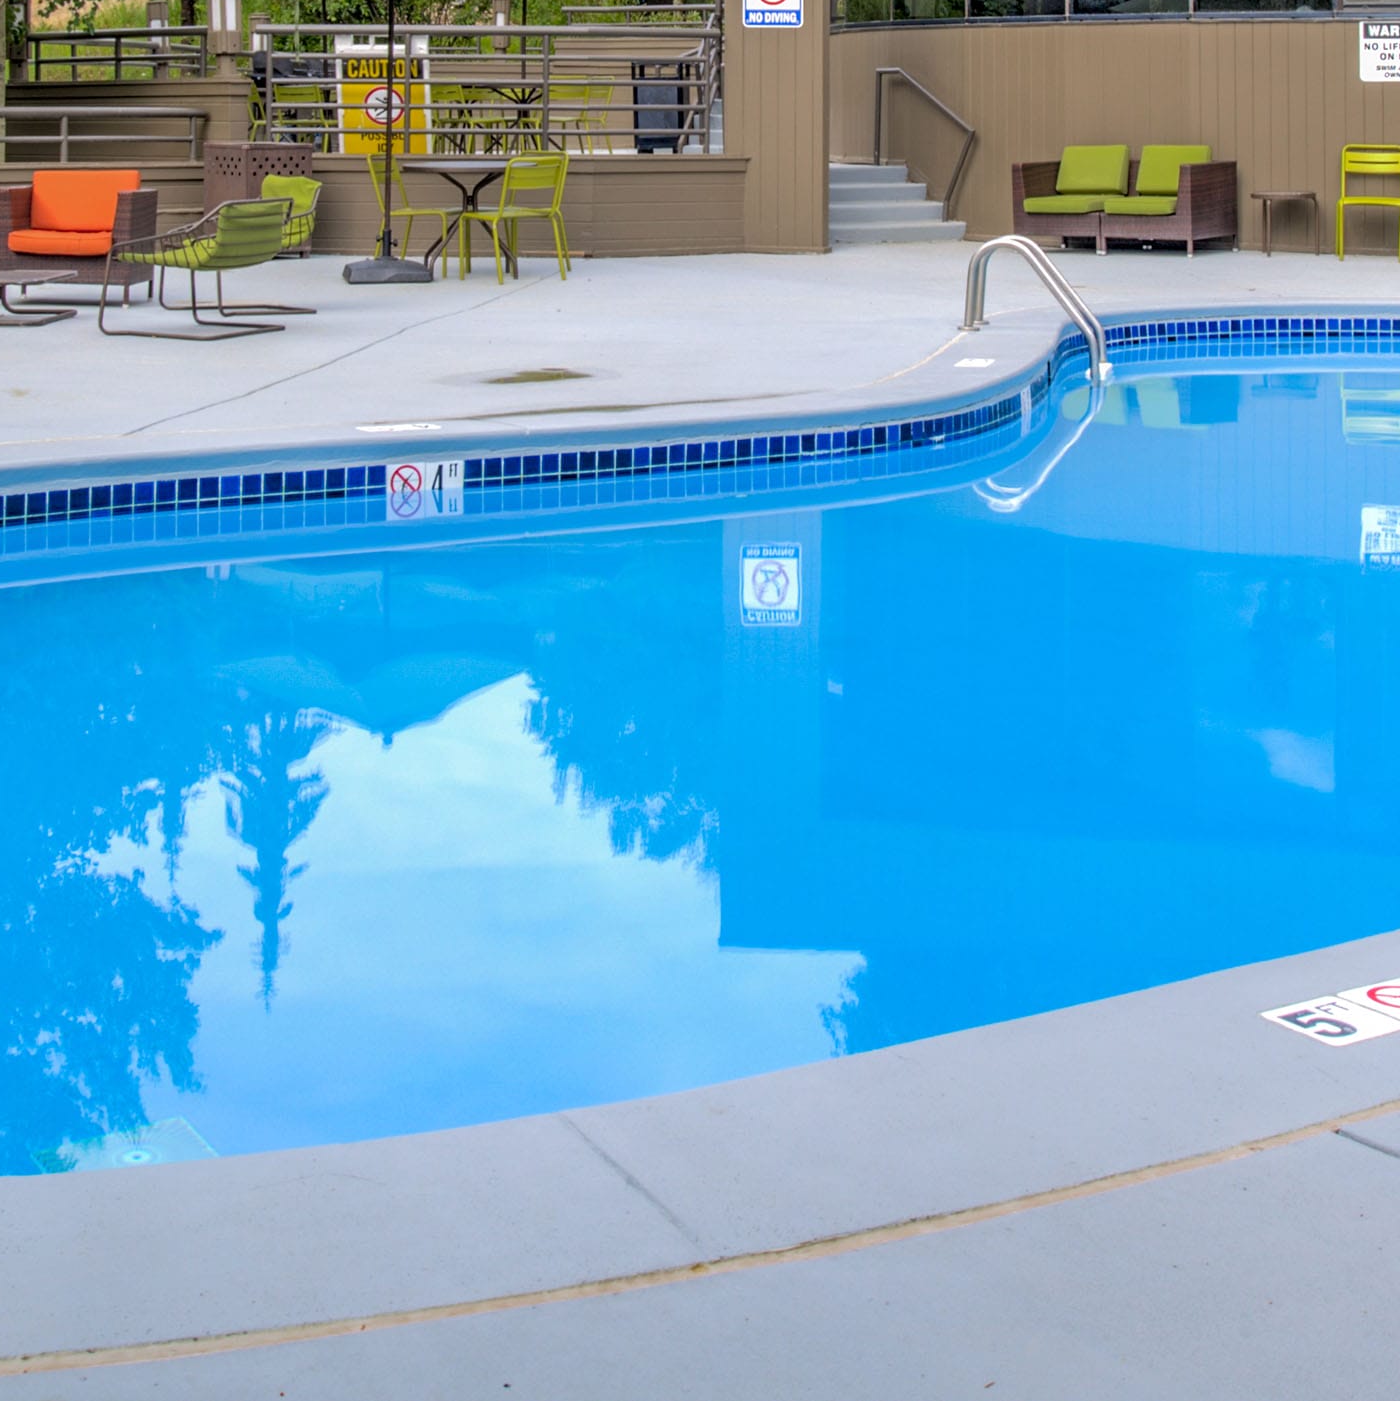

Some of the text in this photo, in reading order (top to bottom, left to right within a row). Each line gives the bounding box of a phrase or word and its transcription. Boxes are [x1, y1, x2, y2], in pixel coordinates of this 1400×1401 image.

[748, 12, 797, 23] NO DIVING
[1364, 42, 1379, 50] NO
[1380, 52, 1394, 61] ON
[347, 59, 418, 78] CAUTON
[431, 463, 458, 490] 4 FT
[1277, 1001, 1357, 1038] 5 FT
